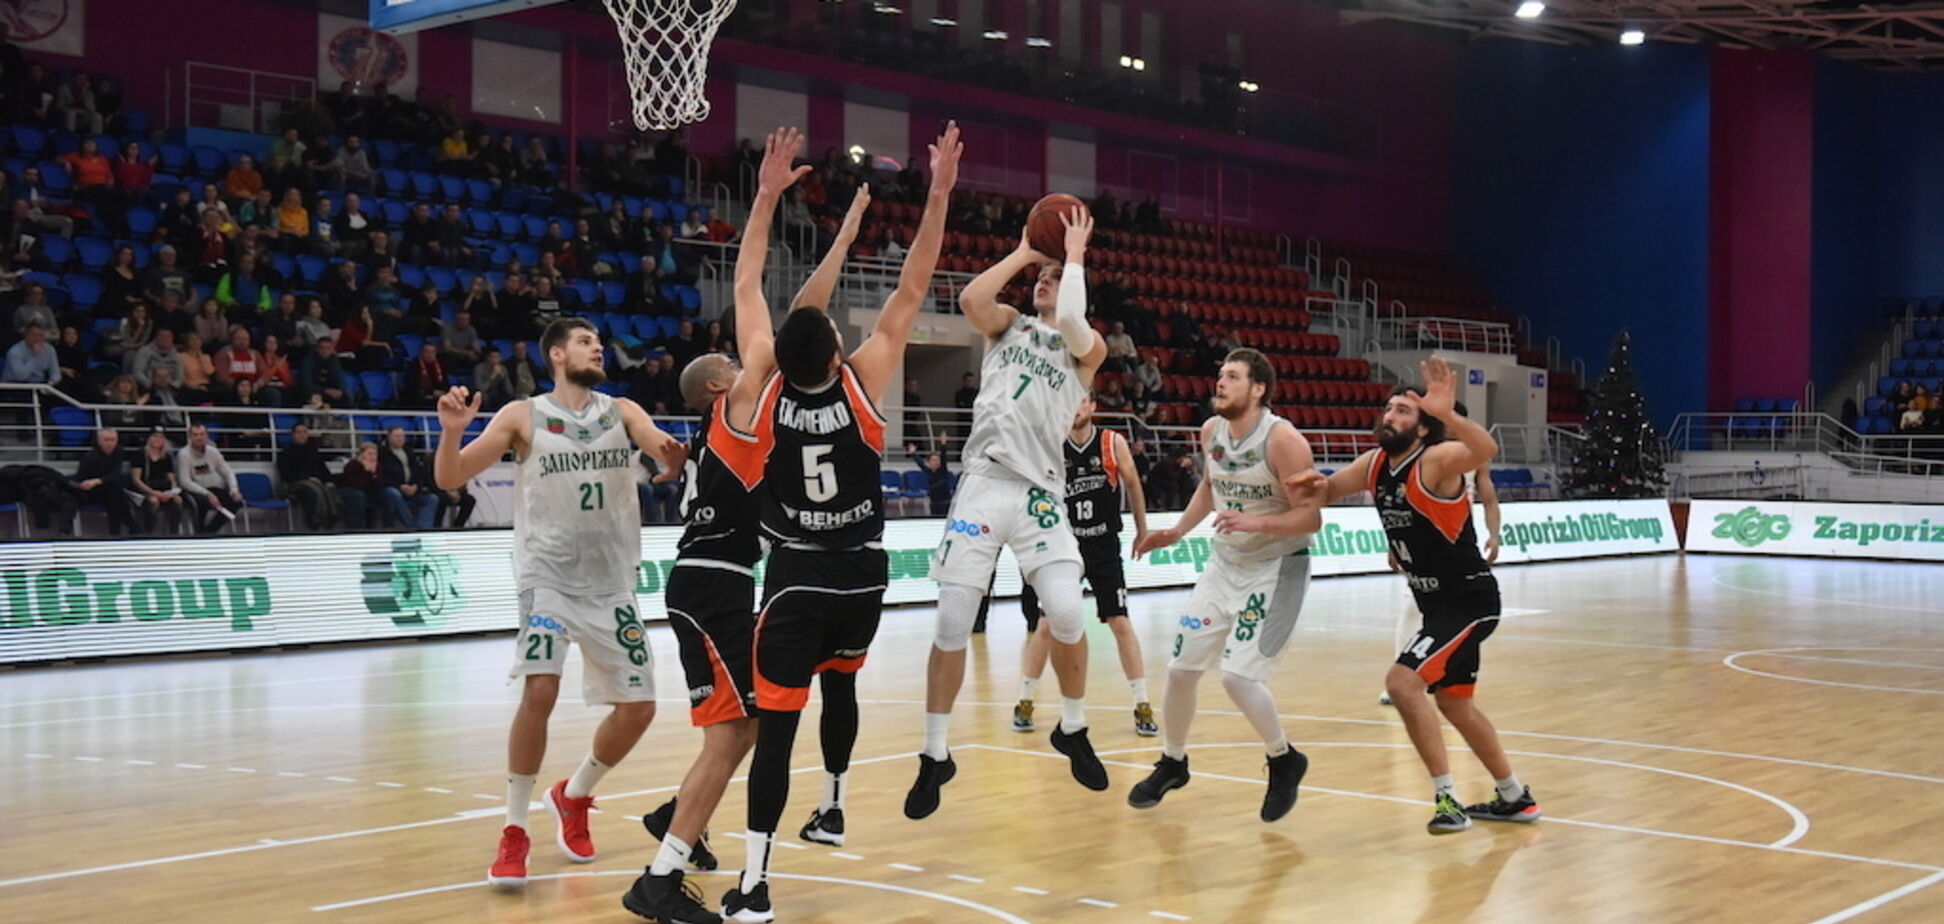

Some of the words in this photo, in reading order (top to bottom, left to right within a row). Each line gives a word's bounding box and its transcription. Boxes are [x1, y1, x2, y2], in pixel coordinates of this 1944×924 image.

[1012, 374, 1033, 401] 7
[540, 448, 630, 477] ЗАПОРІЖЖЯ
[802, 444, 839, 504] 5
[579, 482, 604, 511] 21
[1075, 499, 1094, 521] 13
[1498, 512, 1664, 553] aporizhOilGroup
[525, 633, 554, 660] 21
[1403, 633, 1435, 660] 14
